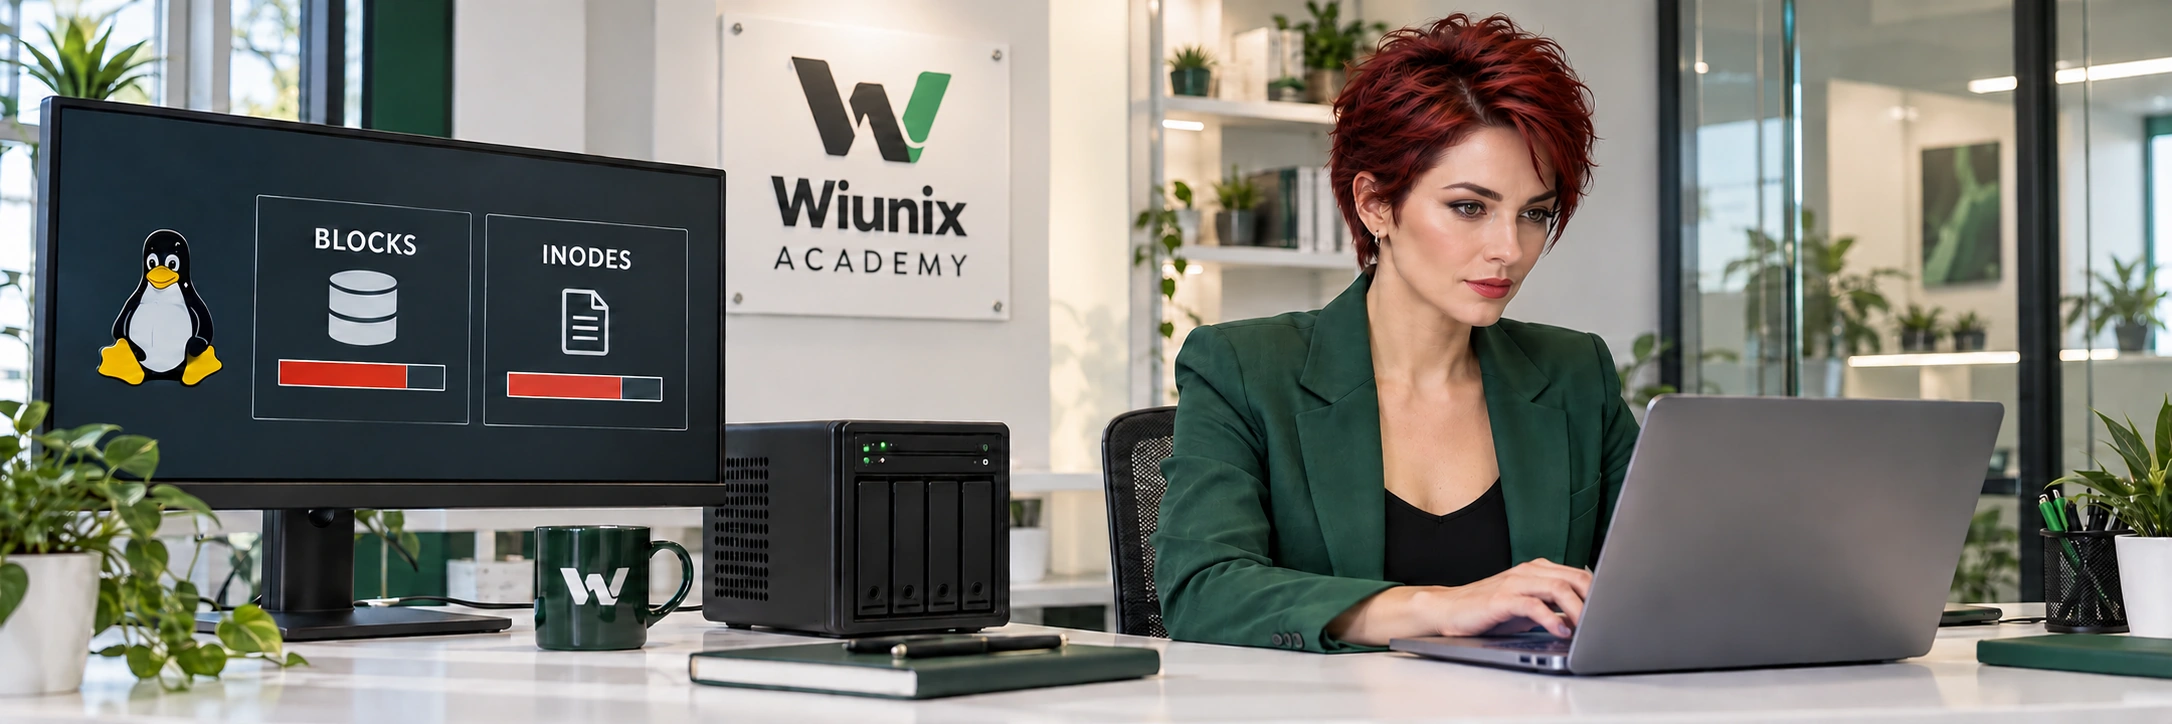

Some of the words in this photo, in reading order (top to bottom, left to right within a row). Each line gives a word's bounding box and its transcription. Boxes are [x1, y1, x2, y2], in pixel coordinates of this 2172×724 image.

[771, 176, 967, 237] Wiunix
[315, 227, 417, 256] BLOCKS
[543, 244, 632, 270] INODES
[774, 246, 967, 277] ACADEMY
